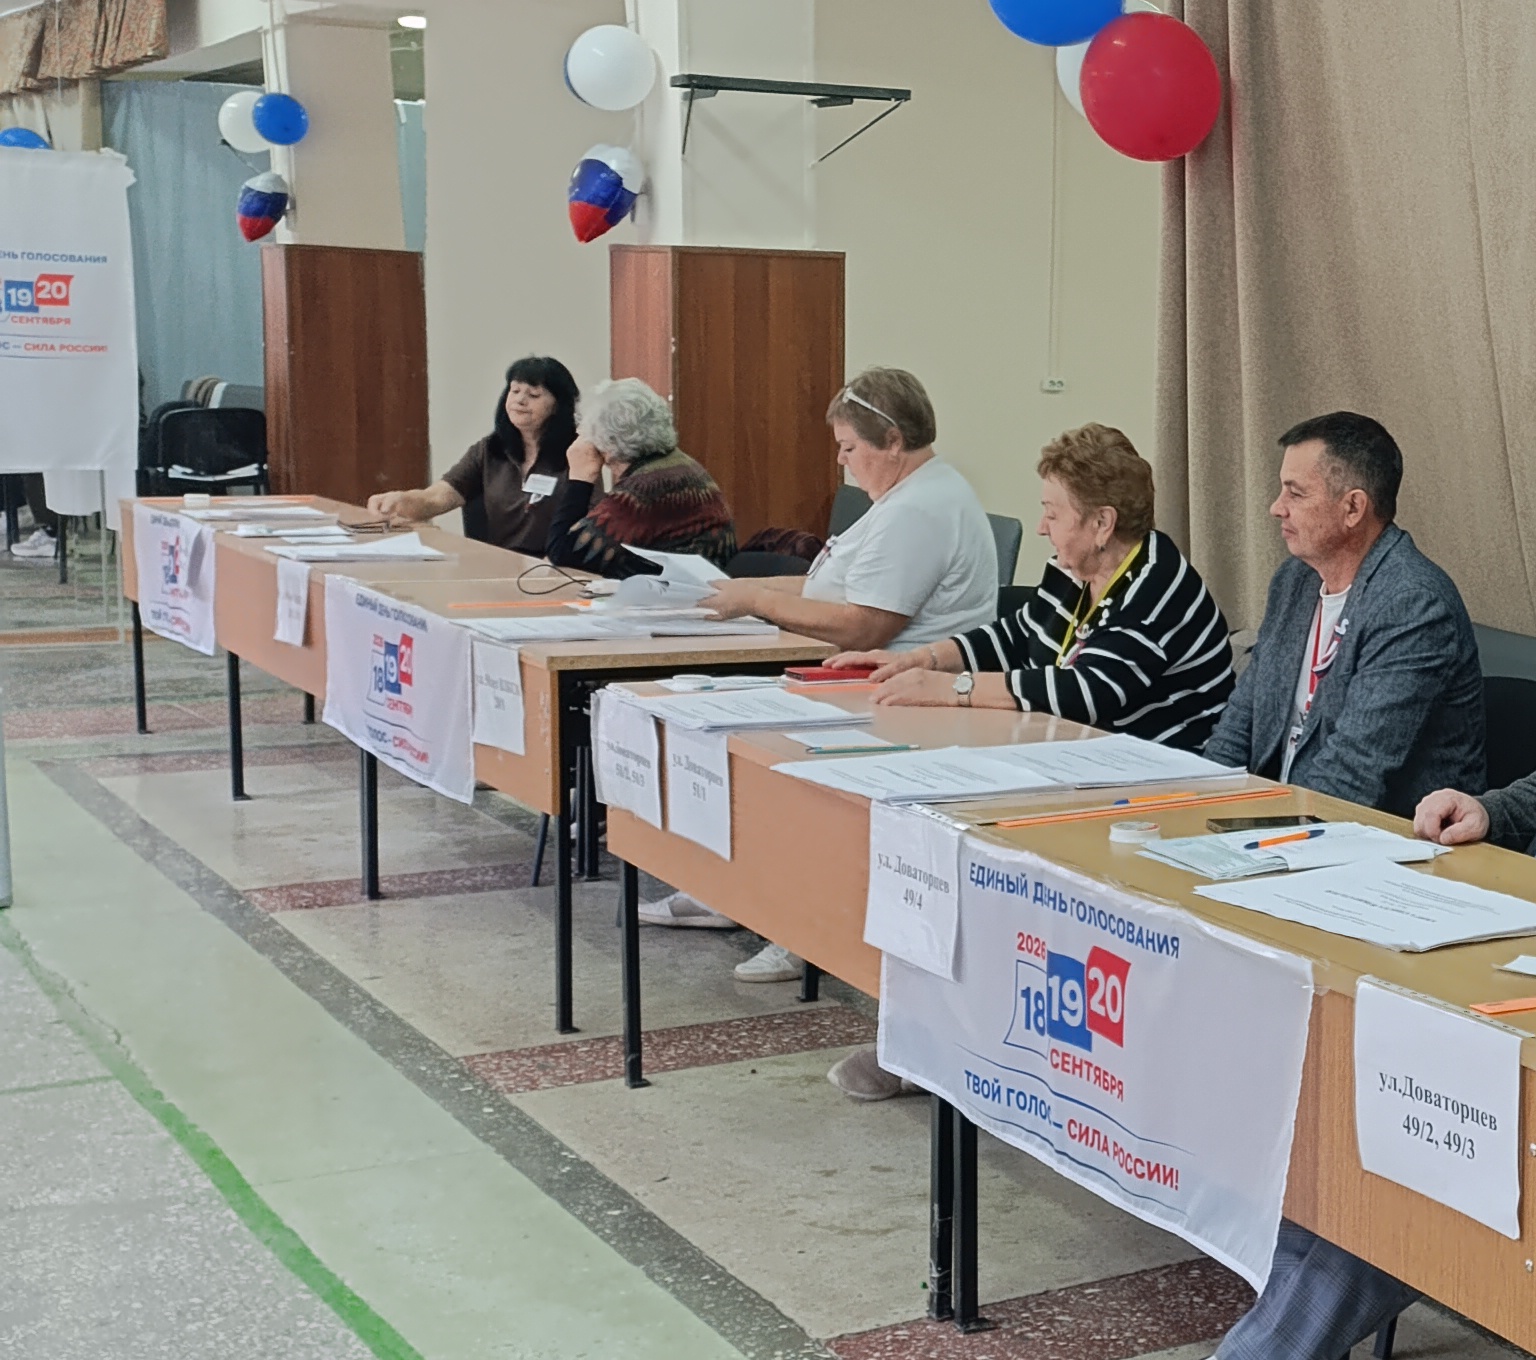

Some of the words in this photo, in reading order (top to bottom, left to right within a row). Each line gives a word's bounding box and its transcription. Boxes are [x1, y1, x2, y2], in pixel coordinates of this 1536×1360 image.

[21, 251, 107, 263] ГОЛОСОВАНИЯ
[7, 287, 33, 307] 19
[37, 280, 68, 300] 20
[11, 315, 71, 326] СЕНТЯБРЯ
[24, 342, 56, 352] СИЛА
[373, 665, 384, 694] 18
[385, 653, 398, 684] 19
[893, 855, 949, 894] Доваторцев
[903, 887, 923, 910] 49/4
[968, 861, 1029, 900] ЕДИНЫЙ
[1070, 897, 1180, 959] ГОЛОСОВАНИЯ
[1016, 931, 1047, 960] 2026
[1020, 986, 1046, 1037] 18
[1048, 974, 1084, 1027] 19
[1088, 967, 1122, 1024] 20
[1049, 1049, 1124, 1102] СЕНТЯБРЯ
[1379, 1072, 1498, 1131] ул.Доваторцев
[964, 1069, 1001, 1104] ТВОЙ
[1067, 1118, 1110, 1157] СИЛА
[1112, 1145, 1180, 1191] РОССИИ!
[1402, 1114, 1439, 1150] 49/2,
[1443, 1130, 1476, 1160] 49/3
